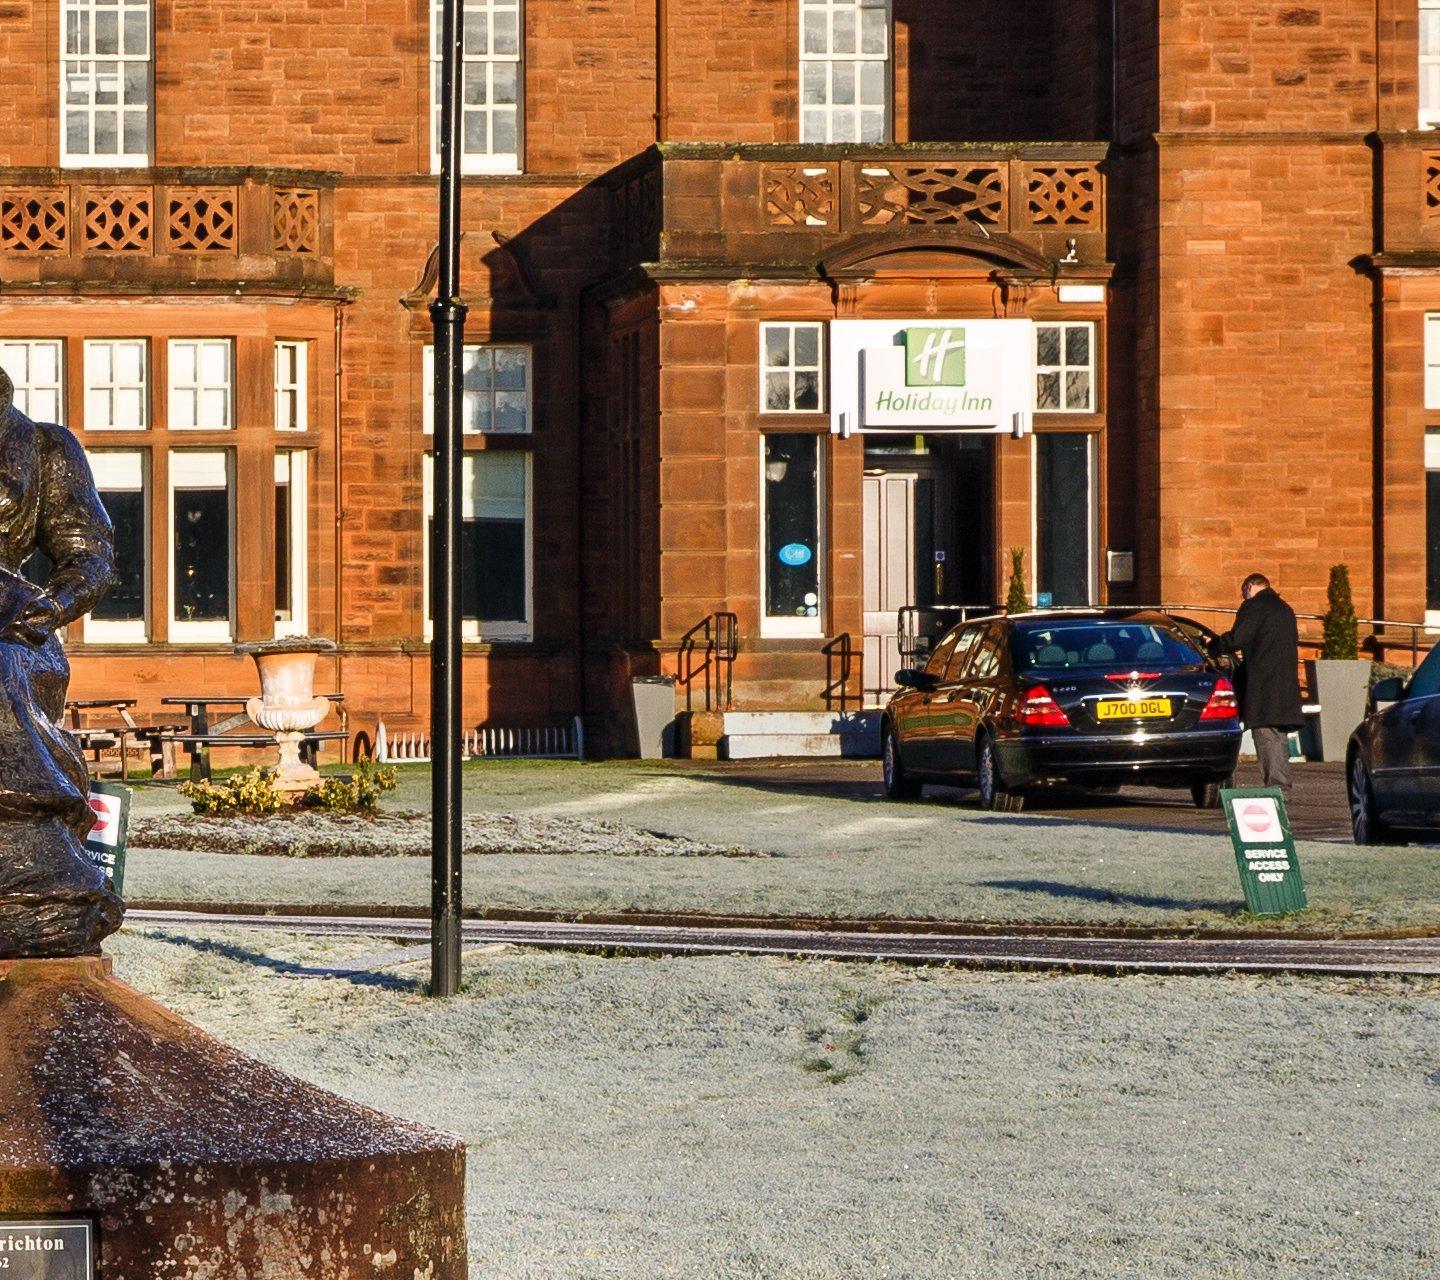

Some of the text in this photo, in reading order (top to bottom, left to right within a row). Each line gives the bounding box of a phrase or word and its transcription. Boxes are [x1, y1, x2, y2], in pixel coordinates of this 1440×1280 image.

[876, 391, 992, 415] Holiday Inn
[1103, 702, 1166, 716] J700 DGL
[85, 850, 116, 865] RVICE
[1244, 849, 1288, 859] SERVICE
[1249, 860, 1290, 871] ACCESS
[1258, 872, 1284, 882] ONLY
